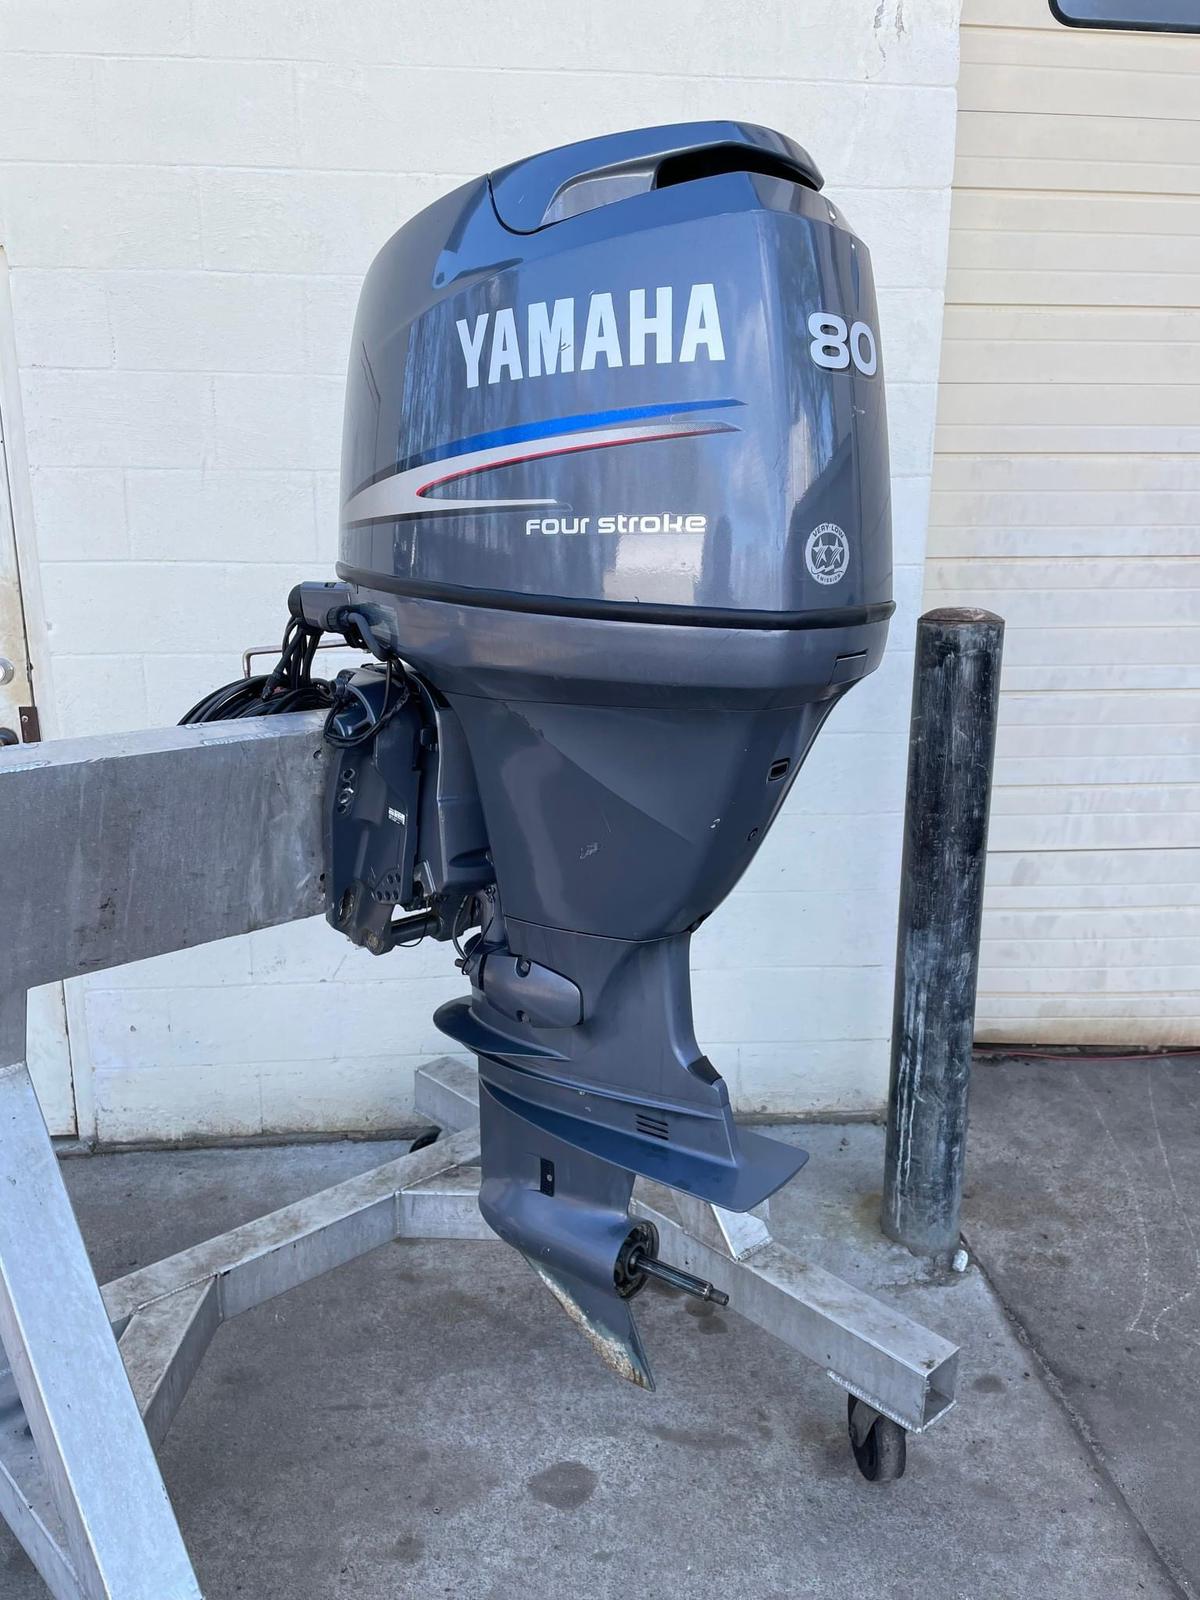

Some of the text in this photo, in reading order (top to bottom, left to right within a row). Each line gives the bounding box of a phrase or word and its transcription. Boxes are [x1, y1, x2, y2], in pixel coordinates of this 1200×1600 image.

[456, 283, 726, 389] YAMAHA
[808, 312, 877, 376] 80
[812, 524, 845, 538] VERY LOW
